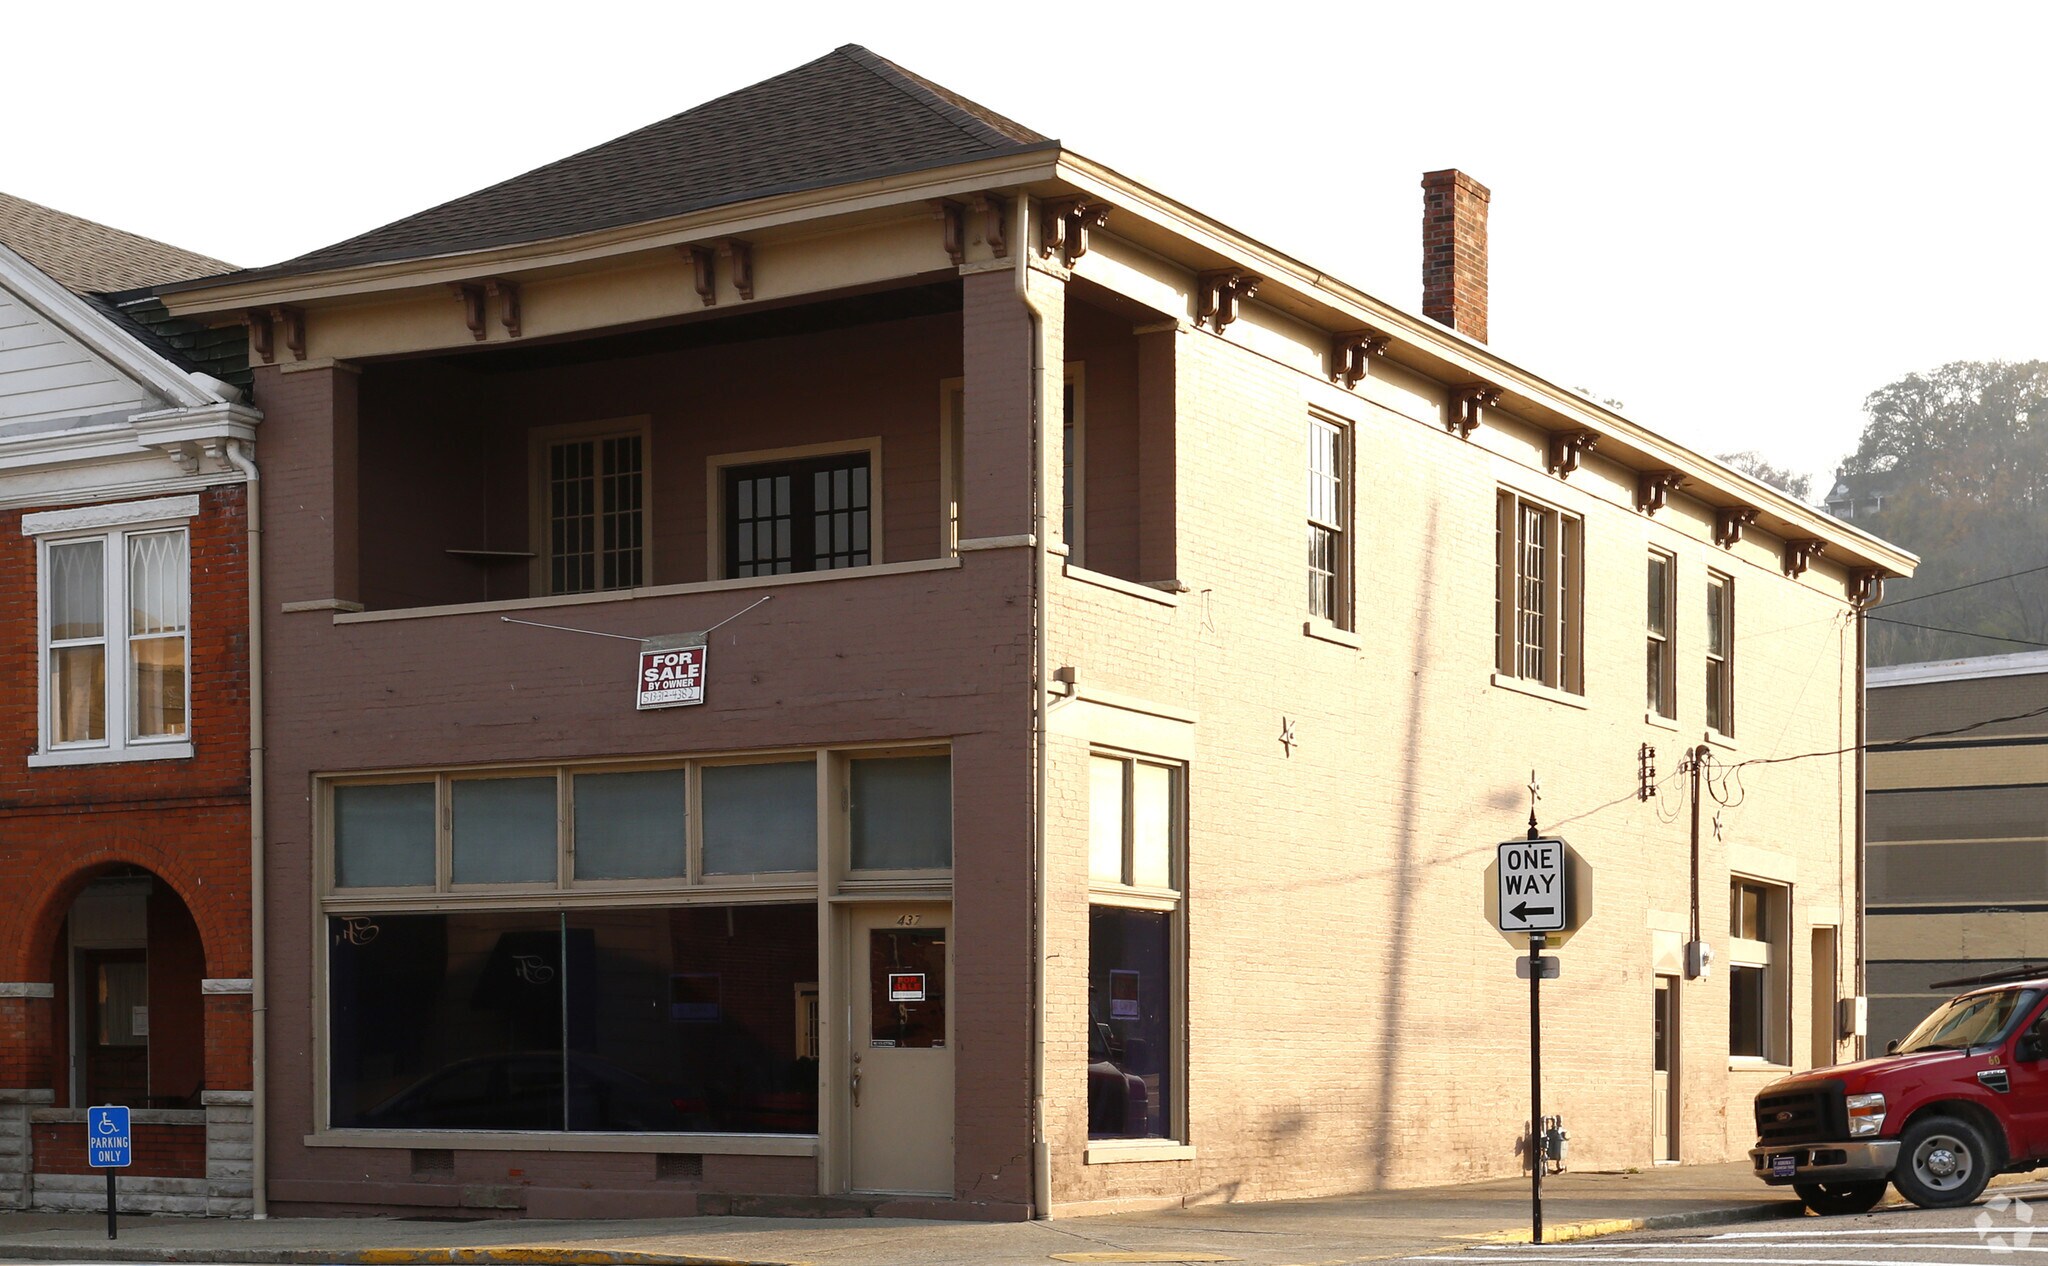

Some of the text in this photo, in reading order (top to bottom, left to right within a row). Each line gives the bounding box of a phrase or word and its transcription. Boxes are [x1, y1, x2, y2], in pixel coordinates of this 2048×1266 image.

[653, 652, 692, 667] FOR
[644, 664, 700, 682] SALE
[648, 678, 694, 690] BY OWNER
[1507, 849, 1554, 870] ONE
[1505, 873, 1556, 895] WAY
[896, 914, 922, 926] 437
[1988, 1055, 2000, 1066] 60
[91, 1137, 128, 1149] PARKING
[98, 1151, 121, 1162] ONLY
